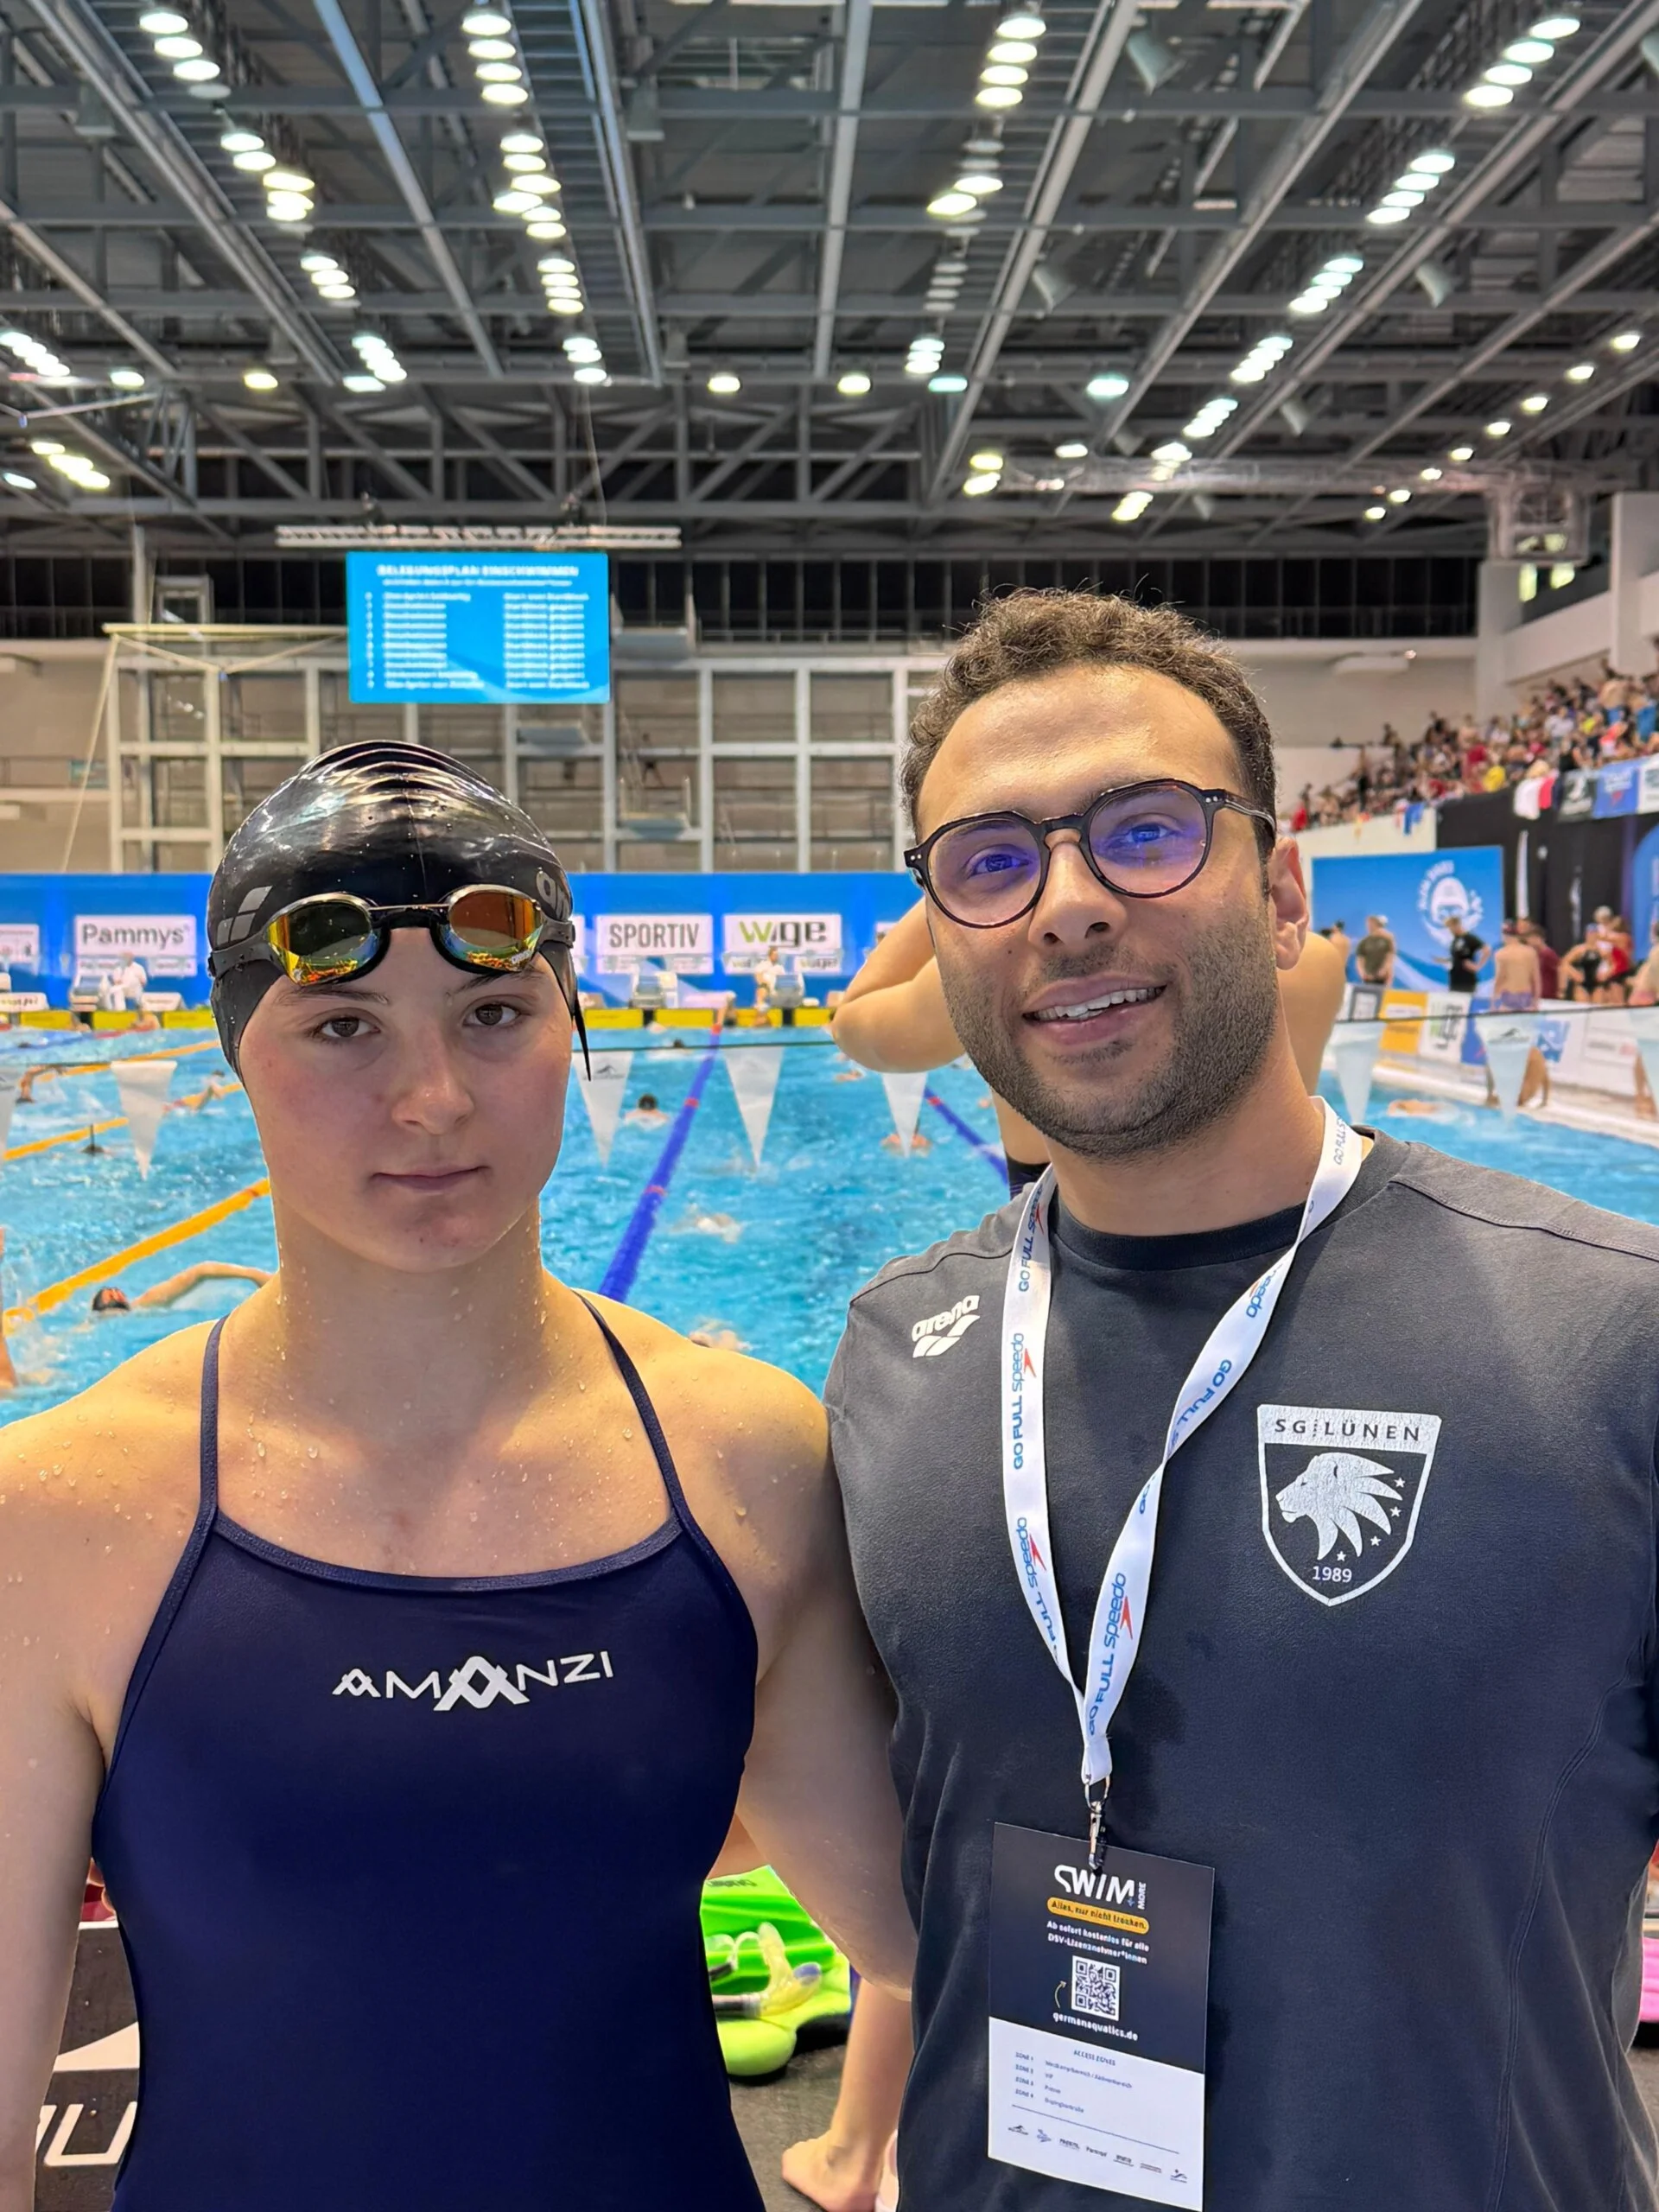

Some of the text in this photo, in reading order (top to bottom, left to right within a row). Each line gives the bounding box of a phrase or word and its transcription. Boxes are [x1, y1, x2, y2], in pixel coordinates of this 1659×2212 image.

[609, 923, 699, 948] SPORTIV
[1020, 1236, 1034, 1268] FULL
[1018, 1269, 1031, 1292] GO
[912, 1295, 980, 1342] arena
[1011, 1332, 1026, 1470] GO FULL speedo
[1176, 1359, 1232, 1427] GO FULL
[1324, 1420, 1420, 1441] LÜNEN
[1016, 1517, 1039, 1588] speedo
[1312, 1566, 1352, 1582] 1989
[1089, 1573, 1127, 1736] GO FULL speedo
[332, 1651, 613, 1711] AMANZI
[1054, 1864, 1135, 1904] SWIM
[1137, 1882, 1147, 1910] MORE
[1046, 1921, 1058, 1929] Ab
[1058, 1923, 1082, 1936] sofort
[1122, 1937, 1134, 1948] für
[1052, 2012, 1138, 2041] germanaquatics.de
